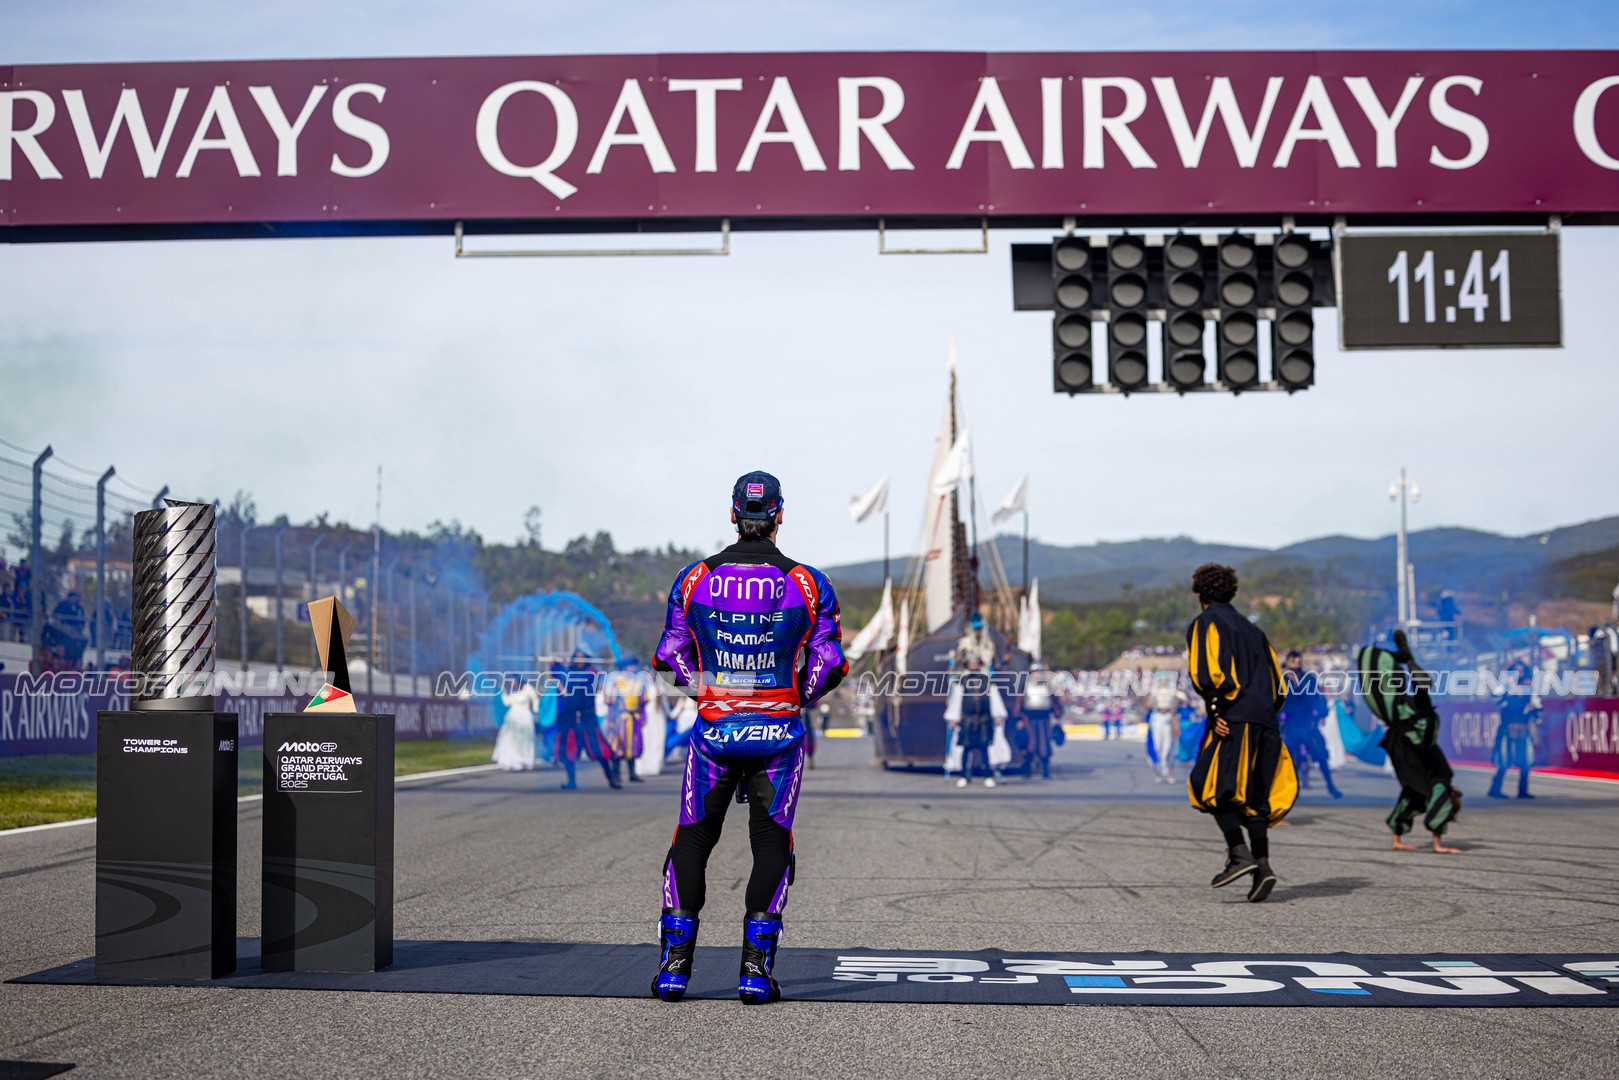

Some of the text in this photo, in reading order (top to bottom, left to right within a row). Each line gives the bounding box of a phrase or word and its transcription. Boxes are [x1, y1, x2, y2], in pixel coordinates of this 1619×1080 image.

[475, 76, 914, 199] QATAR
[946, 75, 1489, 171] AIRWAYS
[1387, 250, 1512, 323] 11:41
[709, 575, 785, 600] prima
[708, 611, 784, 624] ALPINE
[717, 629, 774, 645] PRAMAC
[715, 649, 776, 670] YAMAHA
[17, 690, 89, 740] AIRWAYS
[123, 738, 161, 746] TOWER
[1565, 711, 1609, 762] QATAR
[123, 746, 188, 754] CHAMPIONS
[277, 741, 338, 753] MotoGP
[281, 756, 363, 765] QATAR AIRWAYS
[281, 764, 344, 773] GRAND PRIX
[296, 773, 349, 781] PORTUGAL
[281, 780, 309, 788] 2025
